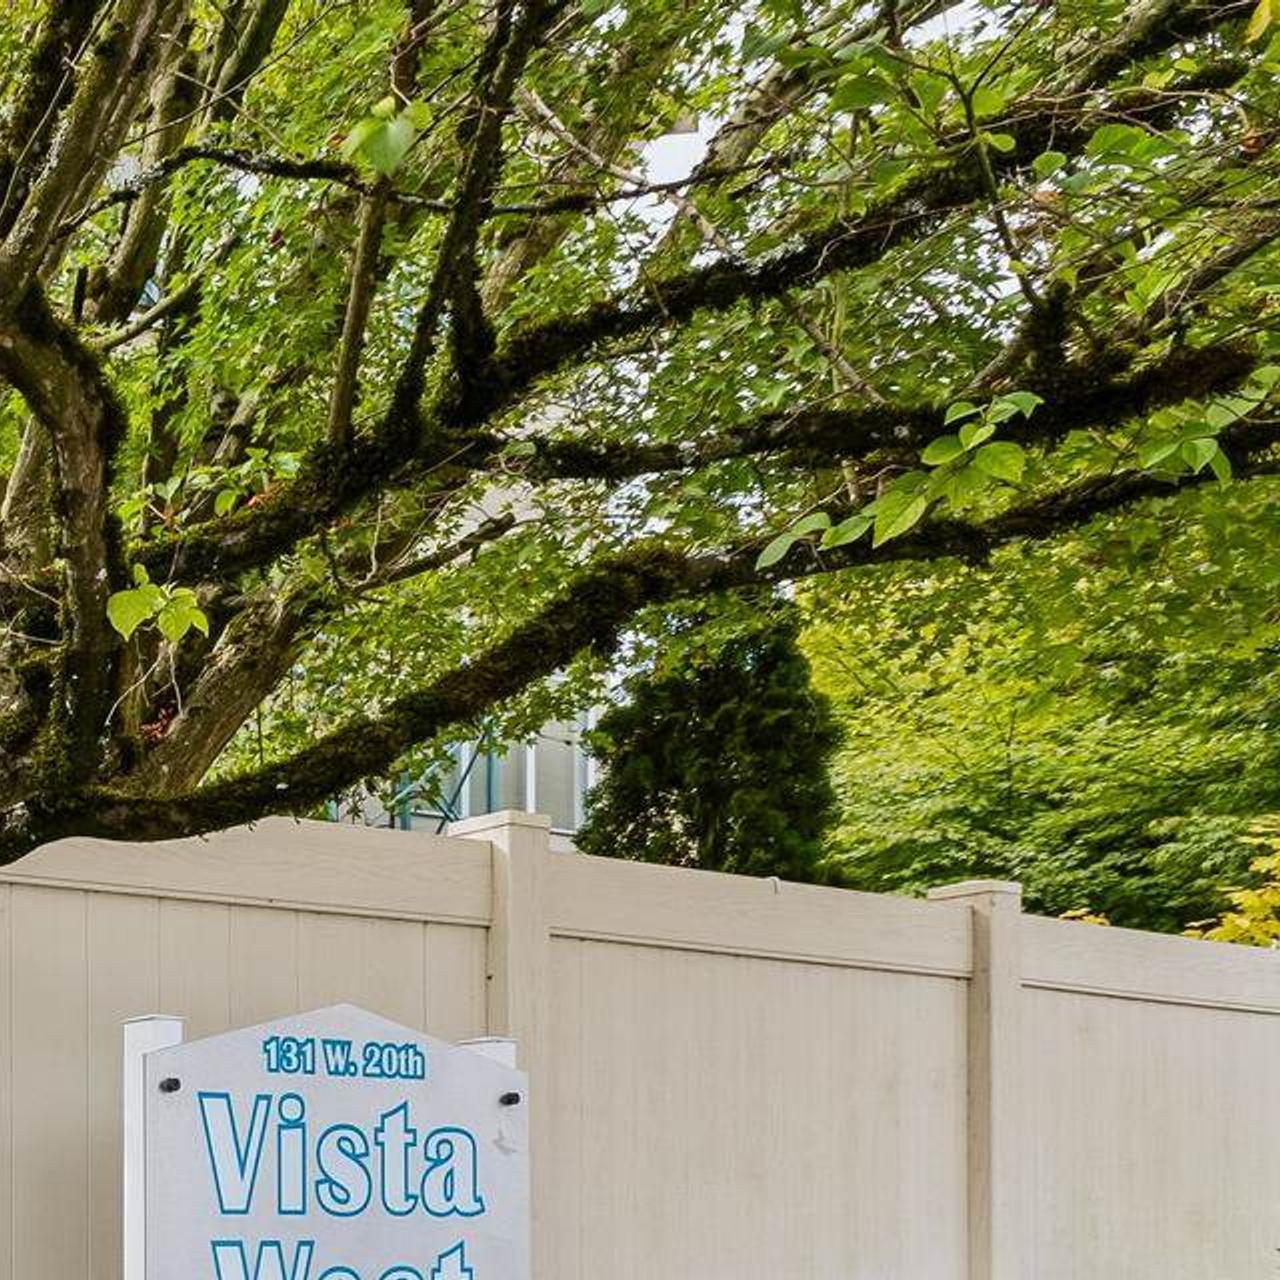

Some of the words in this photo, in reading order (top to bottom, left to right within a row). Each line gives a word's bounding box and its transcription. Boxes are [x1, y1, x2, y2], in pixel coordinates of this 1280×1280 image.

[263, 1036, 315, 1074] 131
[321, 1038, 358, 1076] W.
[362, 1042, 426, 1080] 20th
[198, 1092, 485, 1217] Vista
